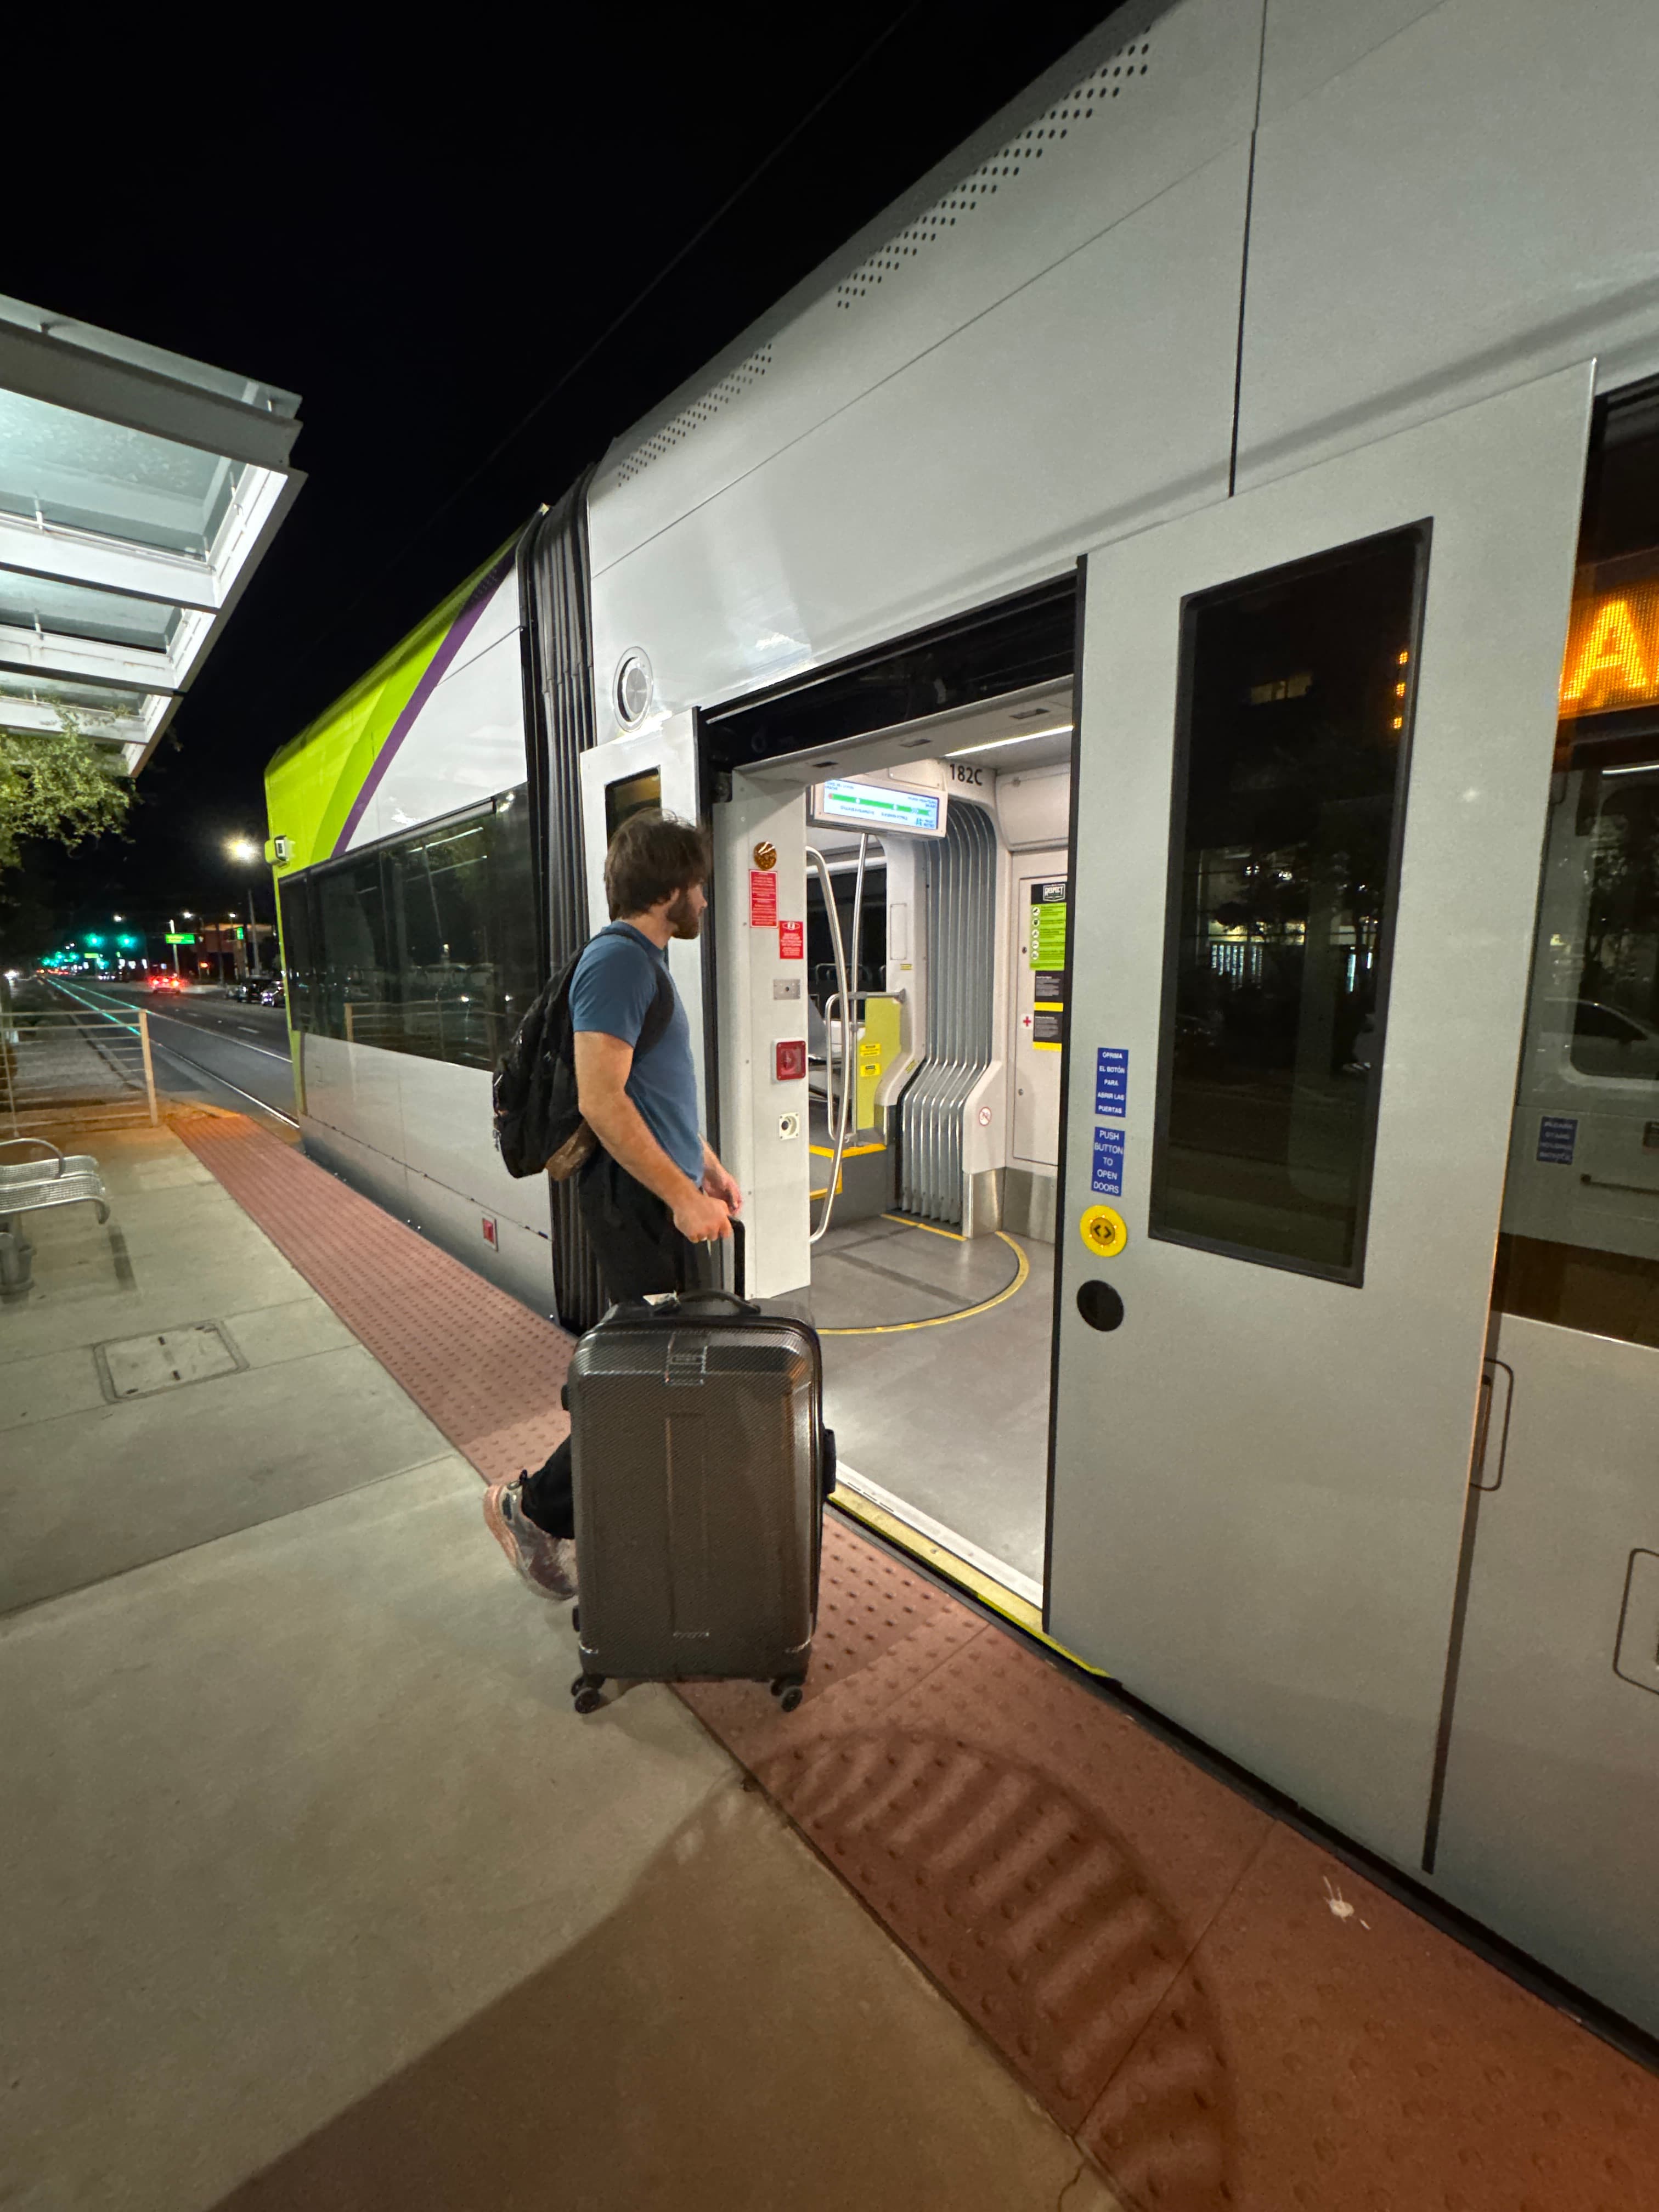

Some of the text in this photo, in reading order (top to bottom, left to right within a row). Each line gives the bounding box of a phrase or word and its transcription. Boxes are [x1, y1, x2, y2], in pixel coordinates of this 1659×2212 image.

[950, 763, 983, 786] 182C
[1098, 1105, 1122, 1114] PUERTAS
[1099, 1130, 1119, 1141] PUSH
[1094, 1142, 1123, 1155] BUTTON
[1102, 1156, 1113, 1166] TO
[1097, 1169, 1117, 1180] OPEN
[1093, 1181, 1119, 1194] DOORS
